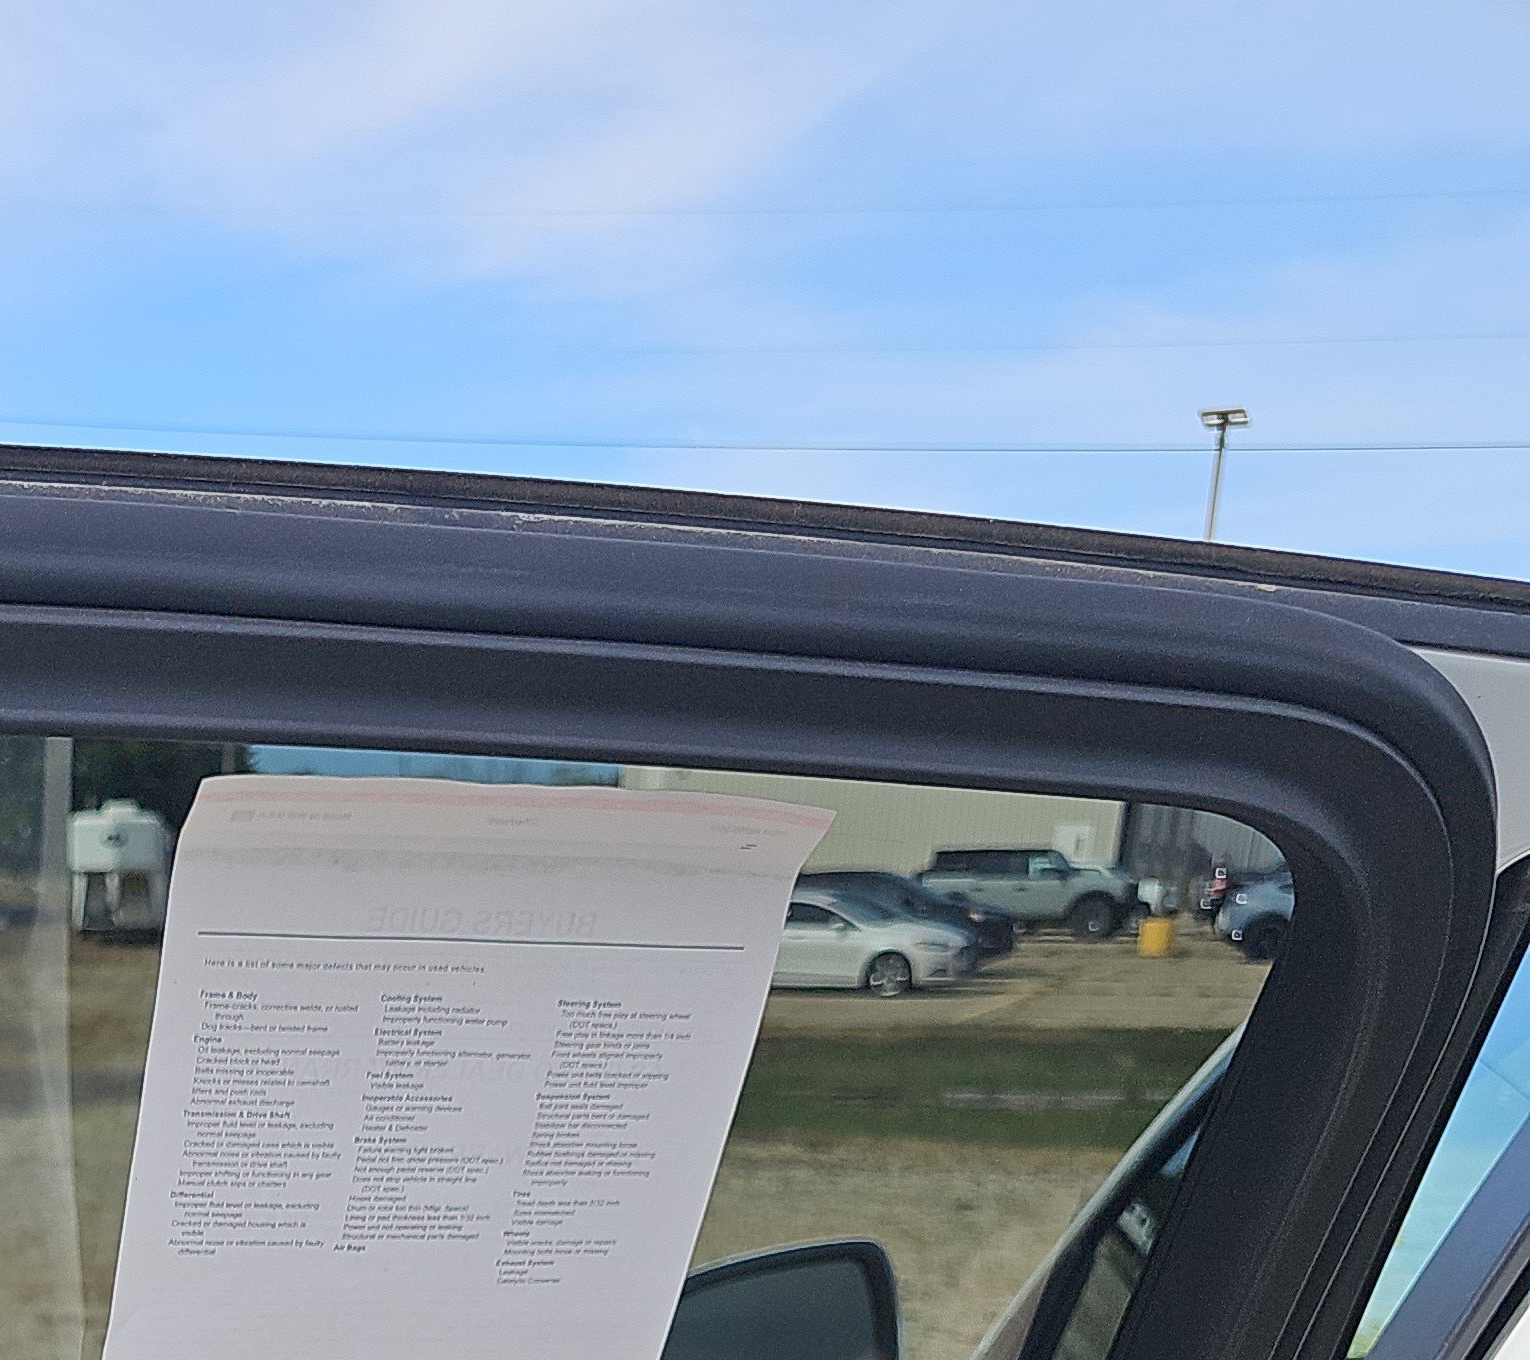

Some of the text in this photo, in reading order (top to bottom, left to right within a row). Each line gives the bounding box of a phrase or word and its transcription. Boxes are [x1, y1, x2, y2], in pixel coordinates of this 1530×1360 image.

[204, 958, 225, 967] Here
[245, 959, 258, 968] list
[297, 960, 320, 971] major
[374, 964, 390, 973] may
[193, 1034, 222, 1045] Engine
